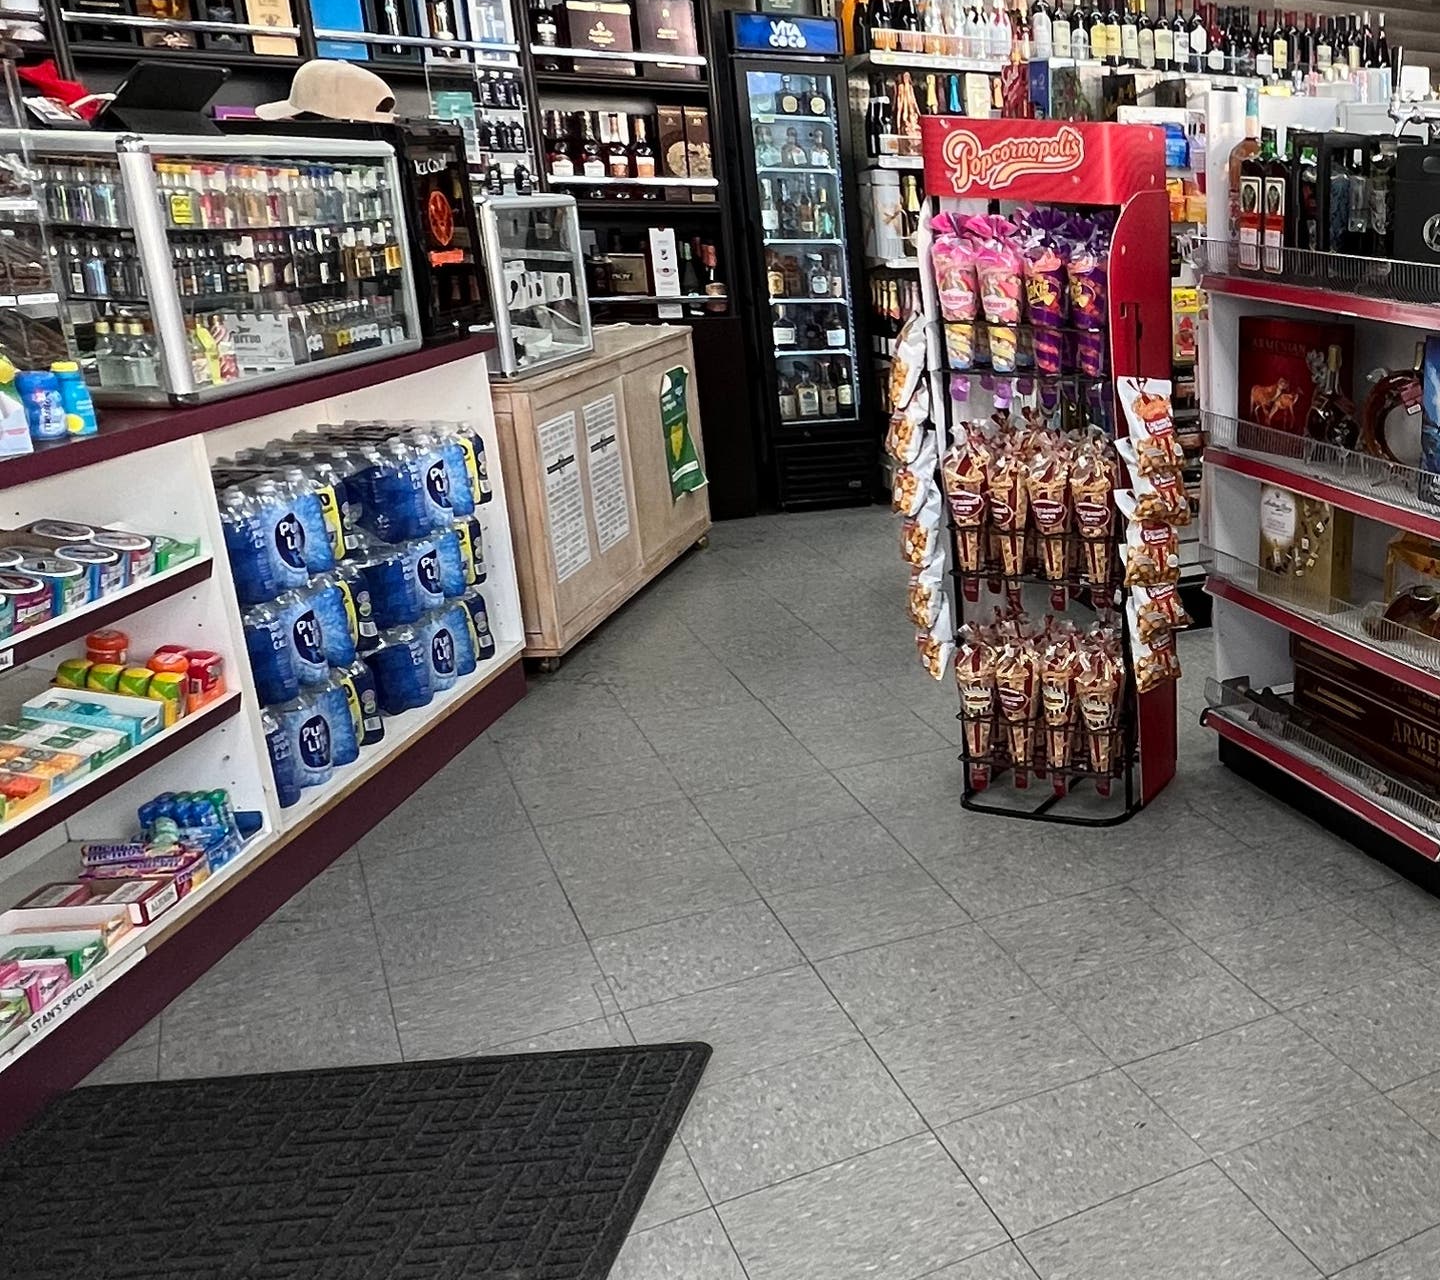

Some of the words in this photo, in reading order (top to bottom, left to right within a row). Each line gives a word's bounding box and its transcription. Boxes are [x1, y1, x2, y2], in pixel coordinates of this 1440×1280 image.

[769, 32, 807, 48] COCO
[770, 21, 801, 38] VITA
[943, 126, 1085, 192] Popcornopolis
[61, 978, 96, 1011] SPECIAL
